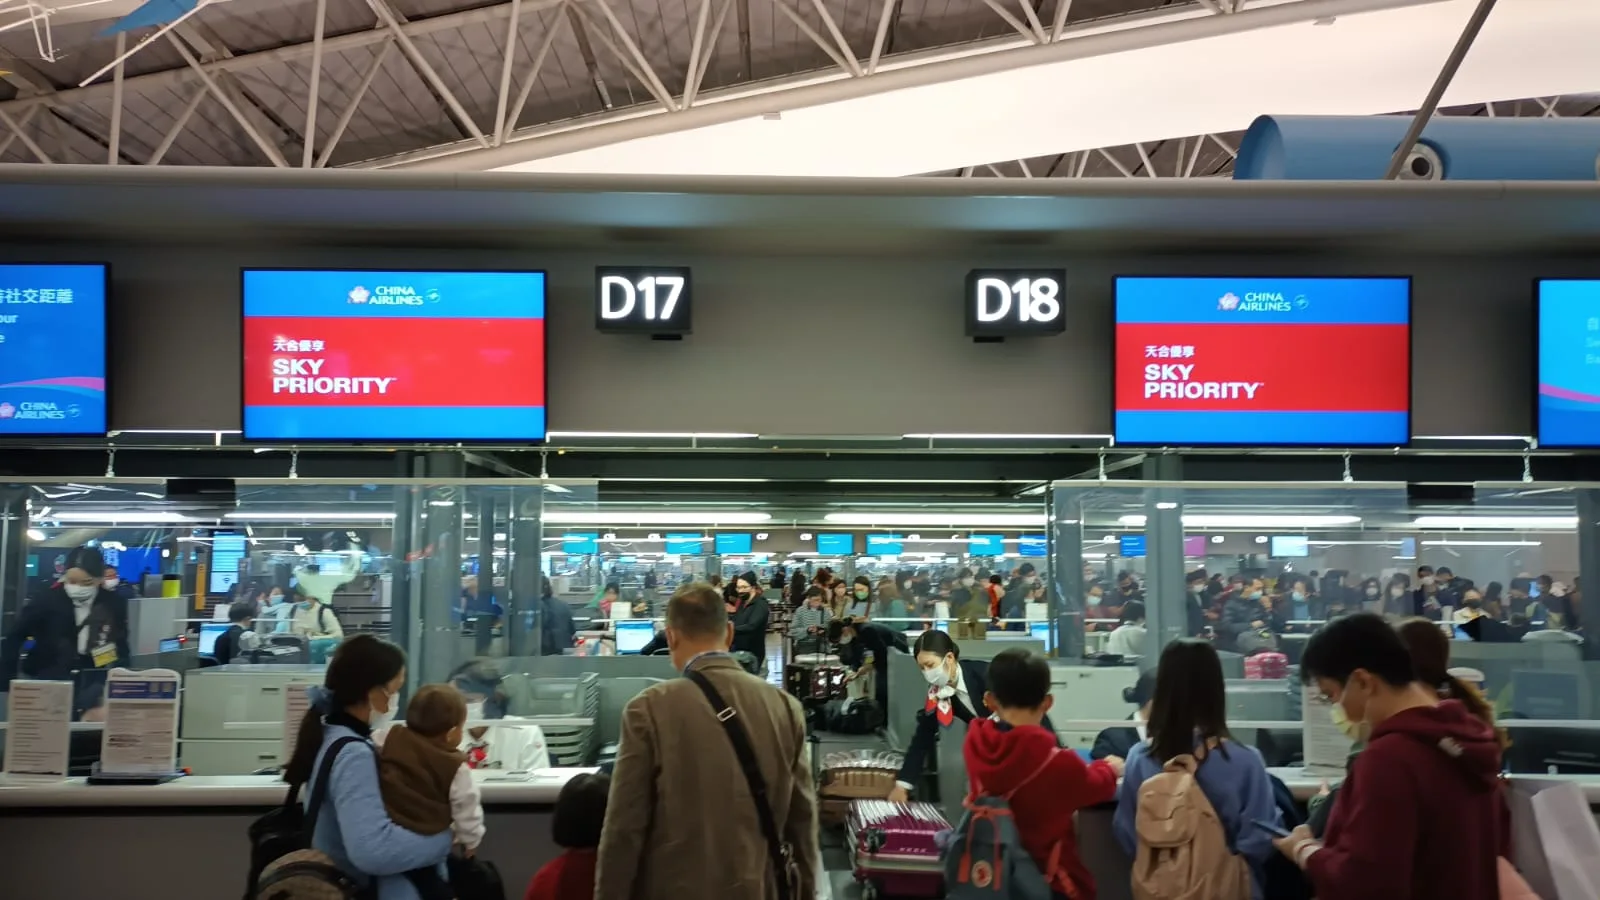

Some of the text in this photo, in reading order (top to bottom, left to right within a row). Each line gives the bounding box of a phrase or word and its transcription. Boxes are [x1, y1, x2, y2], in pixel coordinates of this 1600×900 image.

[0, 288, 73, 304] 社交距離
[375, 286, 416, 295] CHINA
[602, 276, 684, 319] D17
[1245, 292, 1284, 302] CHINA
[369, 296, 424, 305] AIRLINES
[978, 278, 1060, 321] D18
[1238, 302, 1292, 312] AIRLINES
[273, 358, 325, 375] SKY
[1145, 363, 1195, 381] SKY
[273, 377, 392, 394] PRIORITY
[1145, 381, 1259, 399] PRIORITY
[20, 402, 58, 411] CHINA
